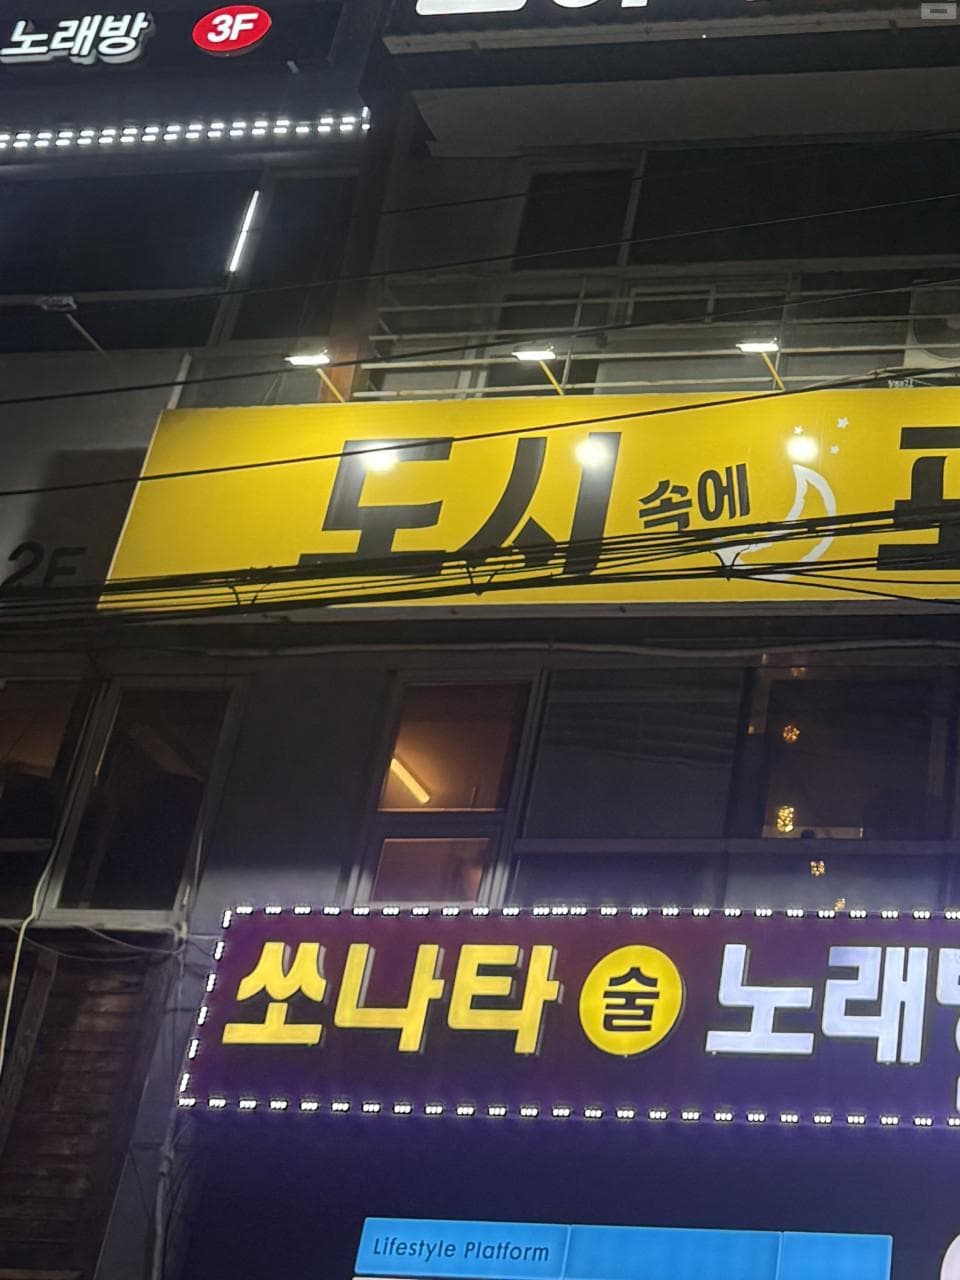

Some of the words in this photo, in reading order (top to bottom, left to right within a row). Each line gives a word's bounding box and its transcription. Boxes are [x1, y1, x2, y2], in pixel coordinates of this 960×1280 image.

[0, 12, 149, 57] 노래방
[207, 13, 259, 43] 3F
[297, 432, 622, 577] 도시
[638, 463, 750, 531] 속에
[0, 540, 86, 589] 2F
[222, 941, 560, 1055] 쏘나타
[603, 966, 661, 1033] 술
[373, 1236, 457, 1263] Lifestyle
[464, 1241, 549, 1262] Platform
